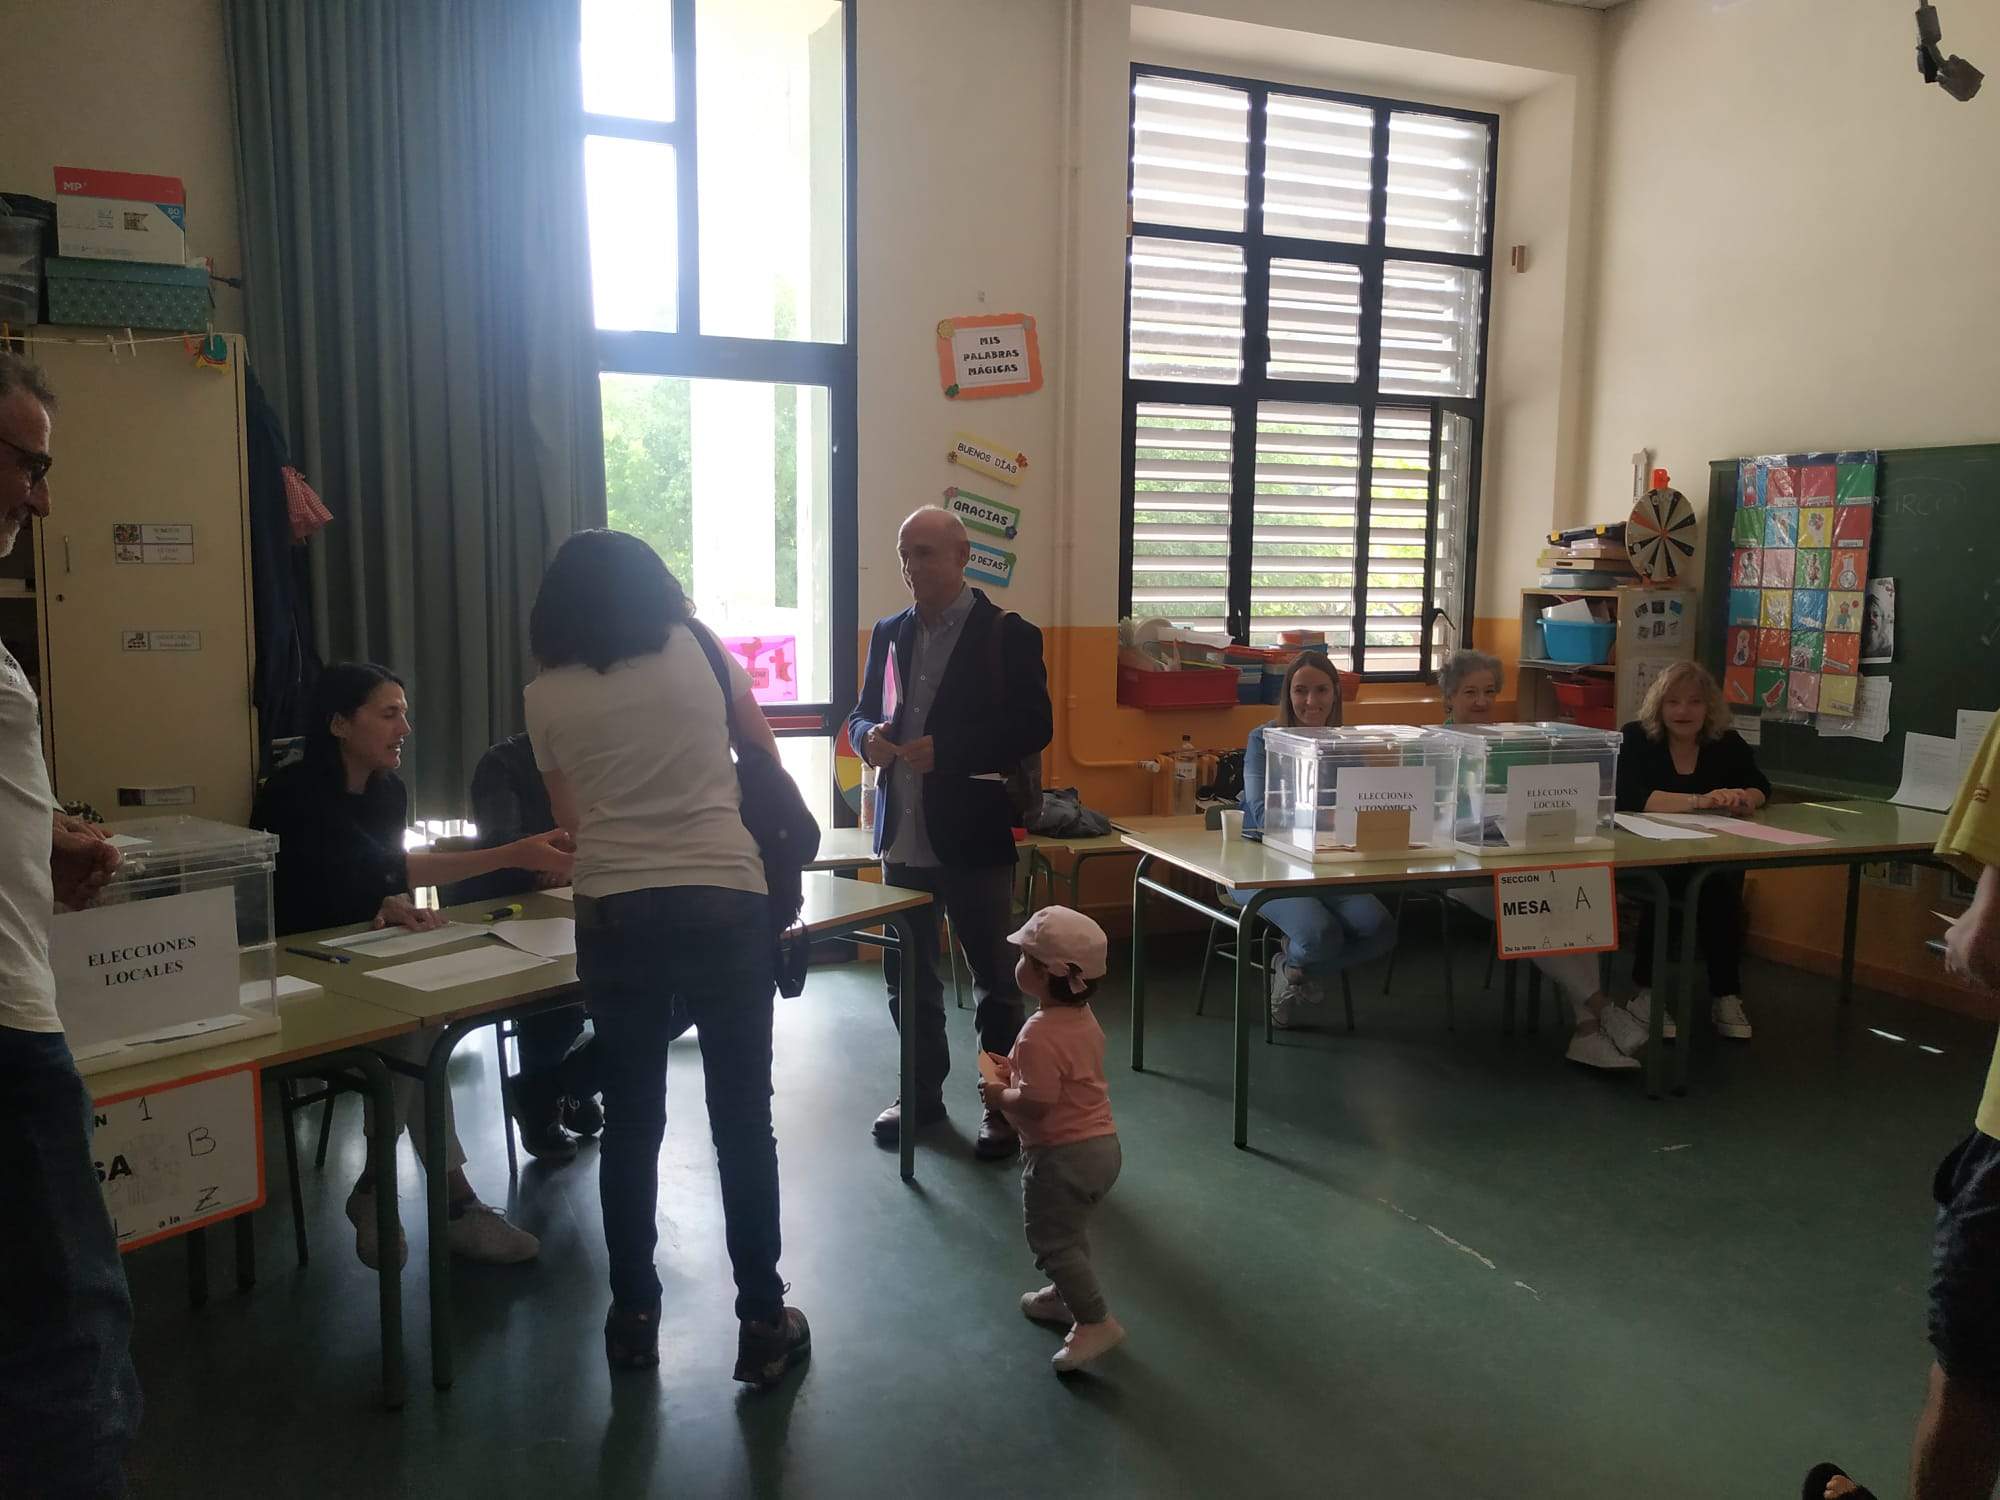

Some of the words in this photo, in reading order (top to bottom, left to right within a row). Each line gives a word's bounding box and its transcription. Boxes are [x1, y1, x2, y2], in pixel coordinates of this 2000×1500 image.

[63, 182, 82, 191] MP
[980, 336, 1001, 346] MIS
[963, 349, 1020, 361] PALABRAS
[968, 363, 1018, 376] MÁGICAS
[957, 442, 992, 463] BUENOS
[994, 458, 1017, 474] DÍAS
[953, 500, 1009, 526] GRACIAS
[977, 555, 1009, 572] DEJAS?
[1358, 792, 1415, 800] ELECCIONES
[1527, 788, 1578, 797] ELECCIONES
[1533, 800, 1571, 809] LOCALES
[1501, 875, 1540, 885] SECCION
[1549, 870, 1556, 883] 1
[1503, 900, 1551, 916] MESA
[1575, 886, 1591, 910] A
[88, 935, 197, 967] ELECCIONES
[105, 959, 184, 986] LOCALES
[138, 1096, 153, 1122] 1
[188, 1127, 217, 1157] B
[194, 1186, 221, 1212] Z
